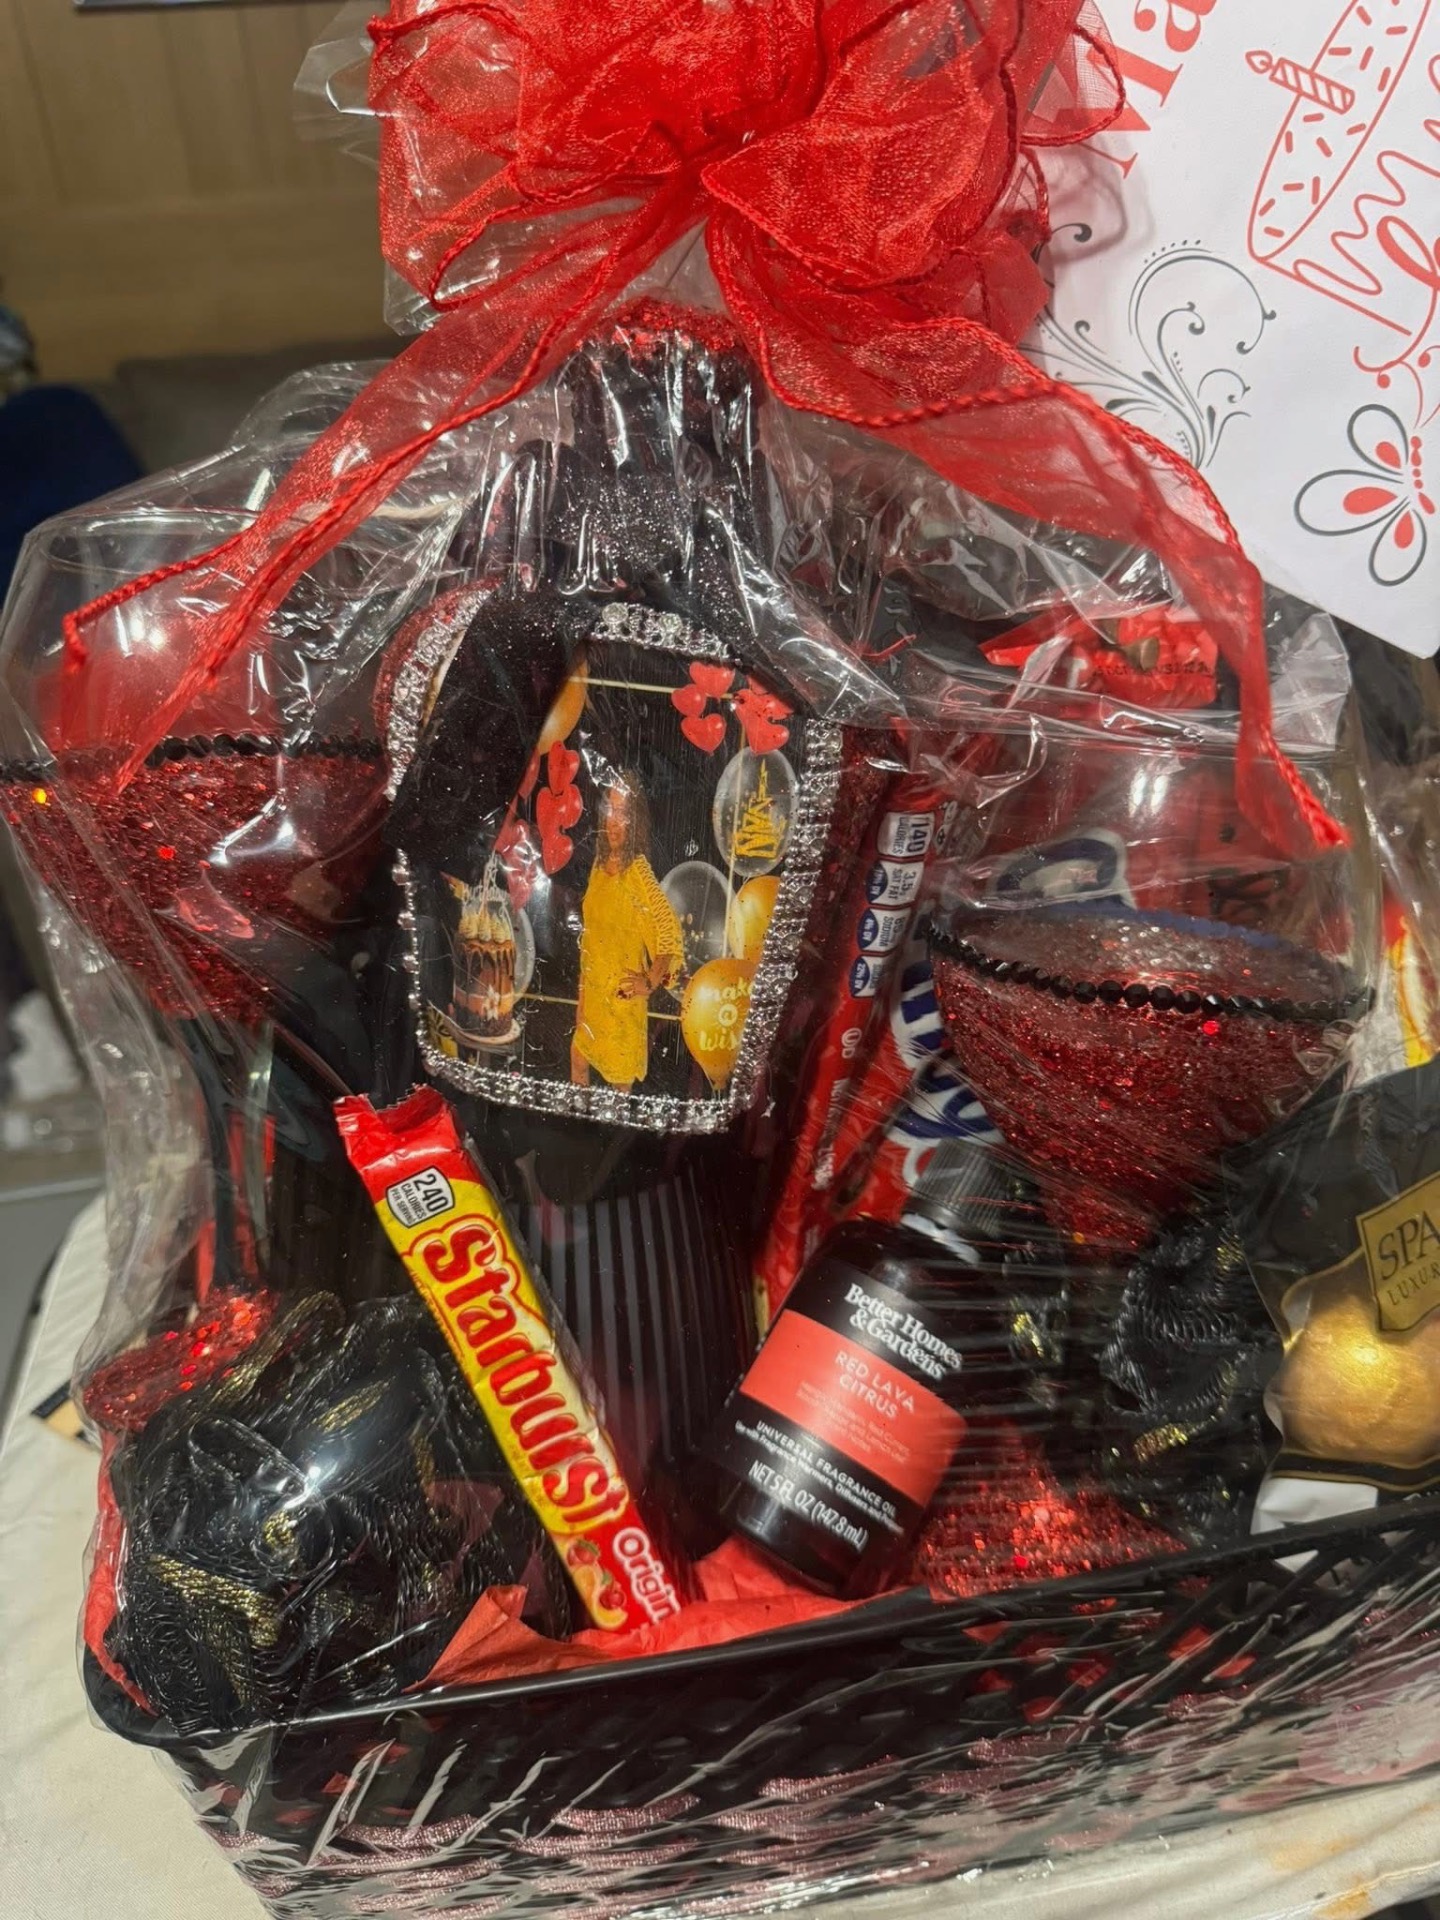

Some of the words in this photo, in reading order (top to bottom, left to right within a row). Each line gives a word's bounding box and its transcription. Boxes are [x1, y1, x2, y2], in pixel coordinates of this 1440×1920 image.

[888, 885, 899, 900] FAT
[390, 1187, 402, 1202] PER
[401, 1183, 427, 1219] CALORIES
[413, 1173, 448, 1212] 240
[1378, 1210, 1440, 1281] SPA
[844, 1283, 904, 1328] Better
[900, 1313, 962, 1370] Homes
[423, 1224, 627, 1524] Starburst
[835, 1351, 868, 1378] RED
[872, 1373, 915, 1413] LAVA
[840, 1373, 898, 1418] CITRUS
[756, 1420, 814, 1462] UNIVERSAL
[815, 1457, 882, 1505] FRAGRANCE
[881, 1500, 897, 1518] OIL
[758, 1434, 797, 1464] Fragrance
[749, 1459, 775, 1485] NET
[778, 1478, 796, 1502] FL
[794, 1489, 816, 1513] OZ
